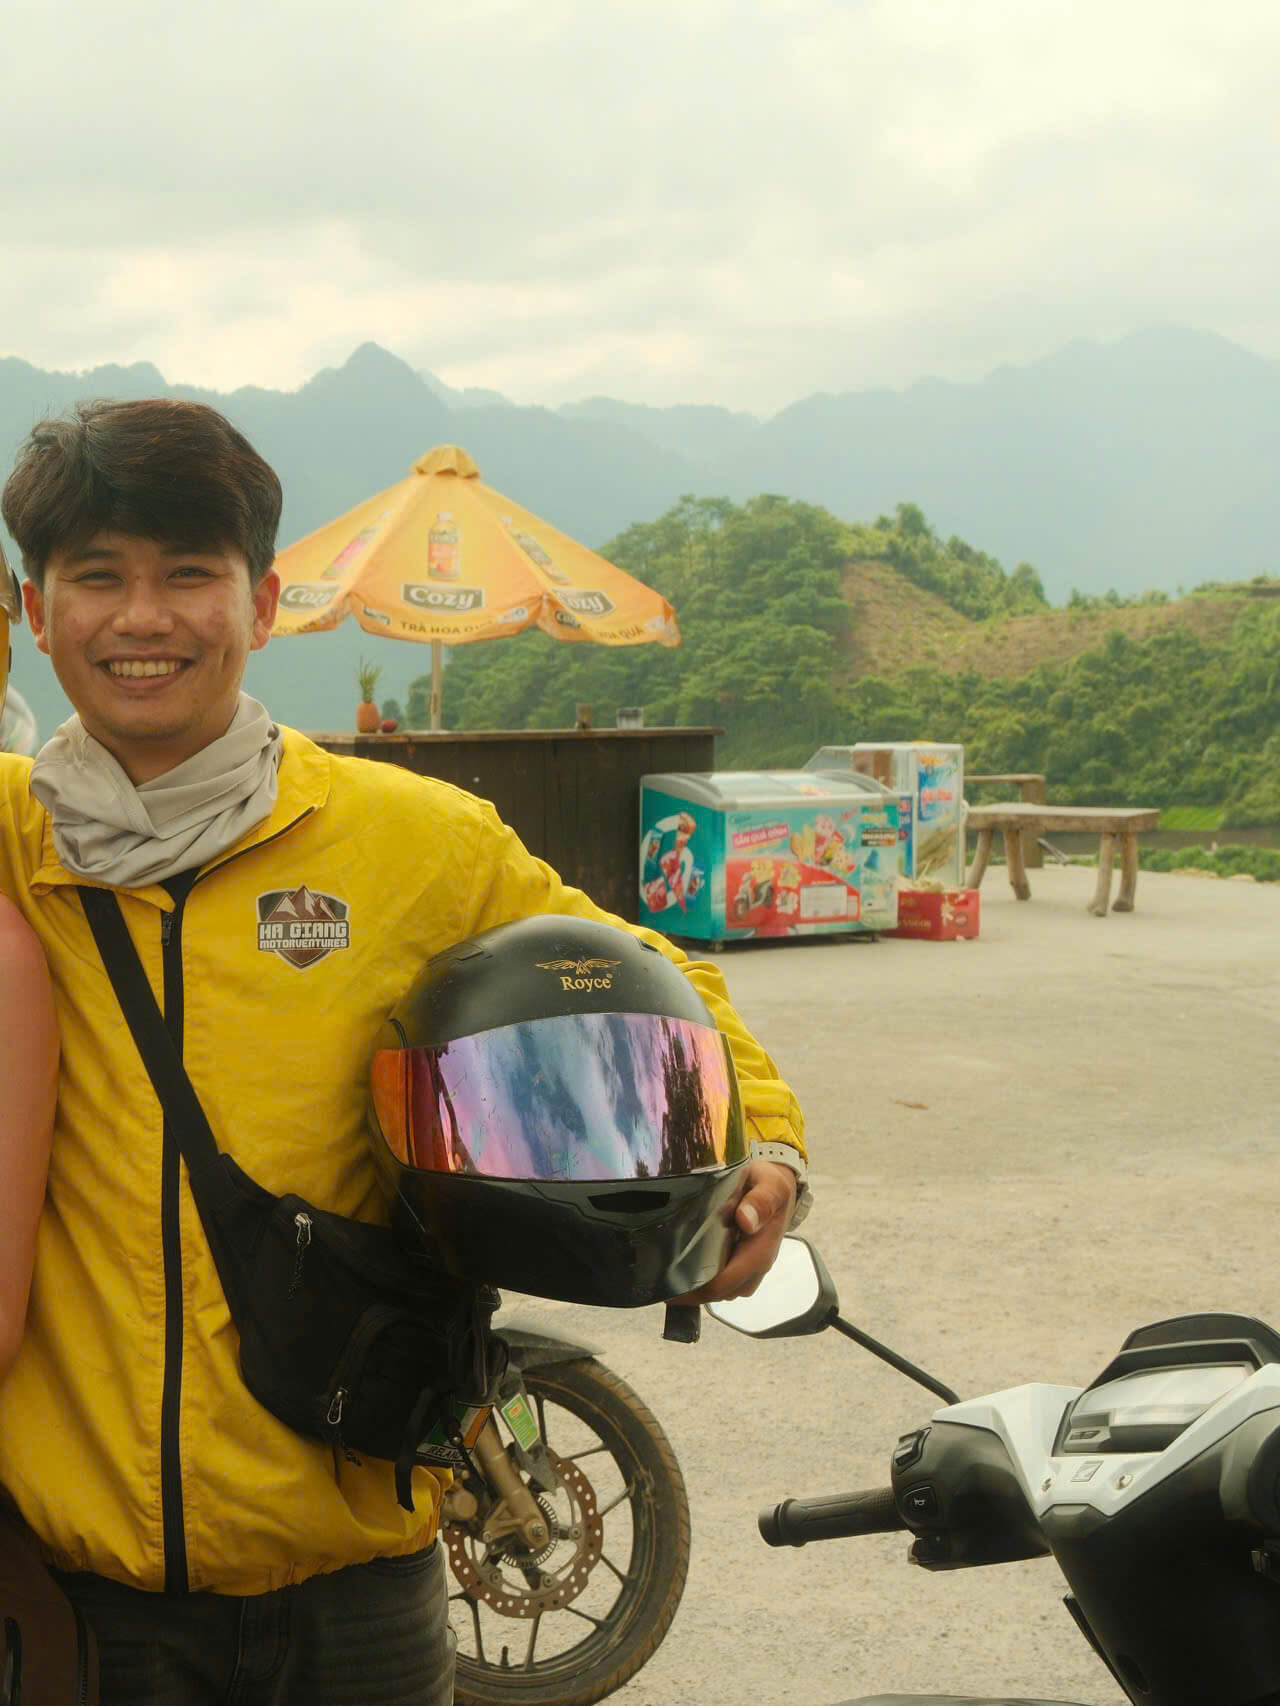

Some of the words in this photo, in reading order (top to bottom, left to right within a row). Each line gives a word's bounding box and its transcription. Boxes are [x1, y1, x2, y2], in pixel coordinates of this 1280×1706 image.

[409, 587, 474, 610] Cozy
[259, 923, 284, 939] HA
[289, 921, 347, 939] GIANG
[259, 938, 348, 949] MOTORVENTURES
[560, 976, 611, 992] Royce
